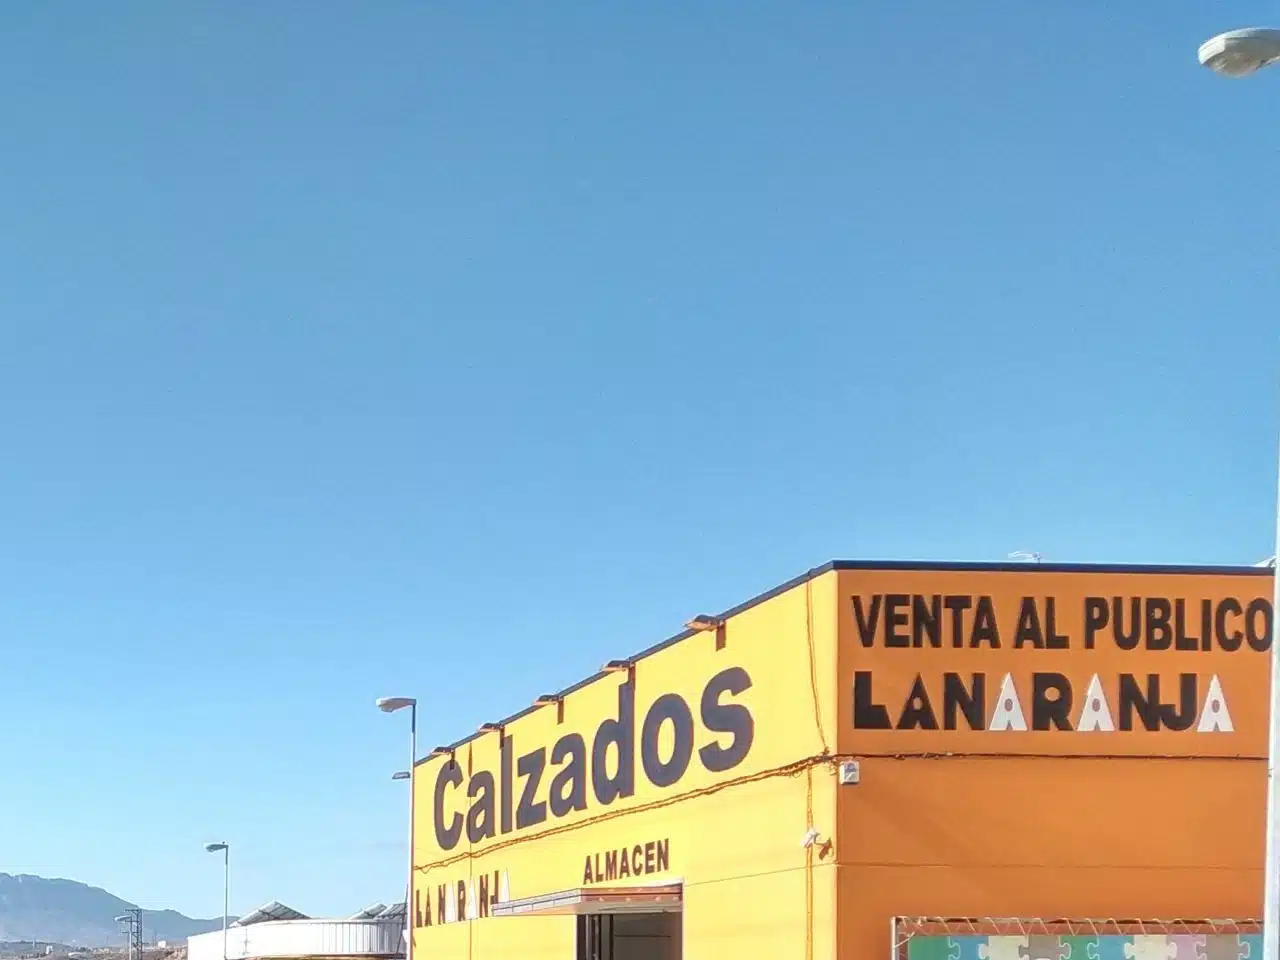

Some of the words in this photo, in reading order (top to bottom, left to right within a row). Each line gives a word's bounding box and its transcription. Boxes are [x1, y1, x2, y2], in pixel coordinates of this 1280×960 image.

[852, 594, 1002, 649] VENTA
[1015, 596, 1070, 650] AL
[1085, 596, 1274, 652] PUBLICO
[433, 666, 755, 850] Calzados
[583, 838, 670, 885] ALMACEN
[416, 887, 432, 928] LA
